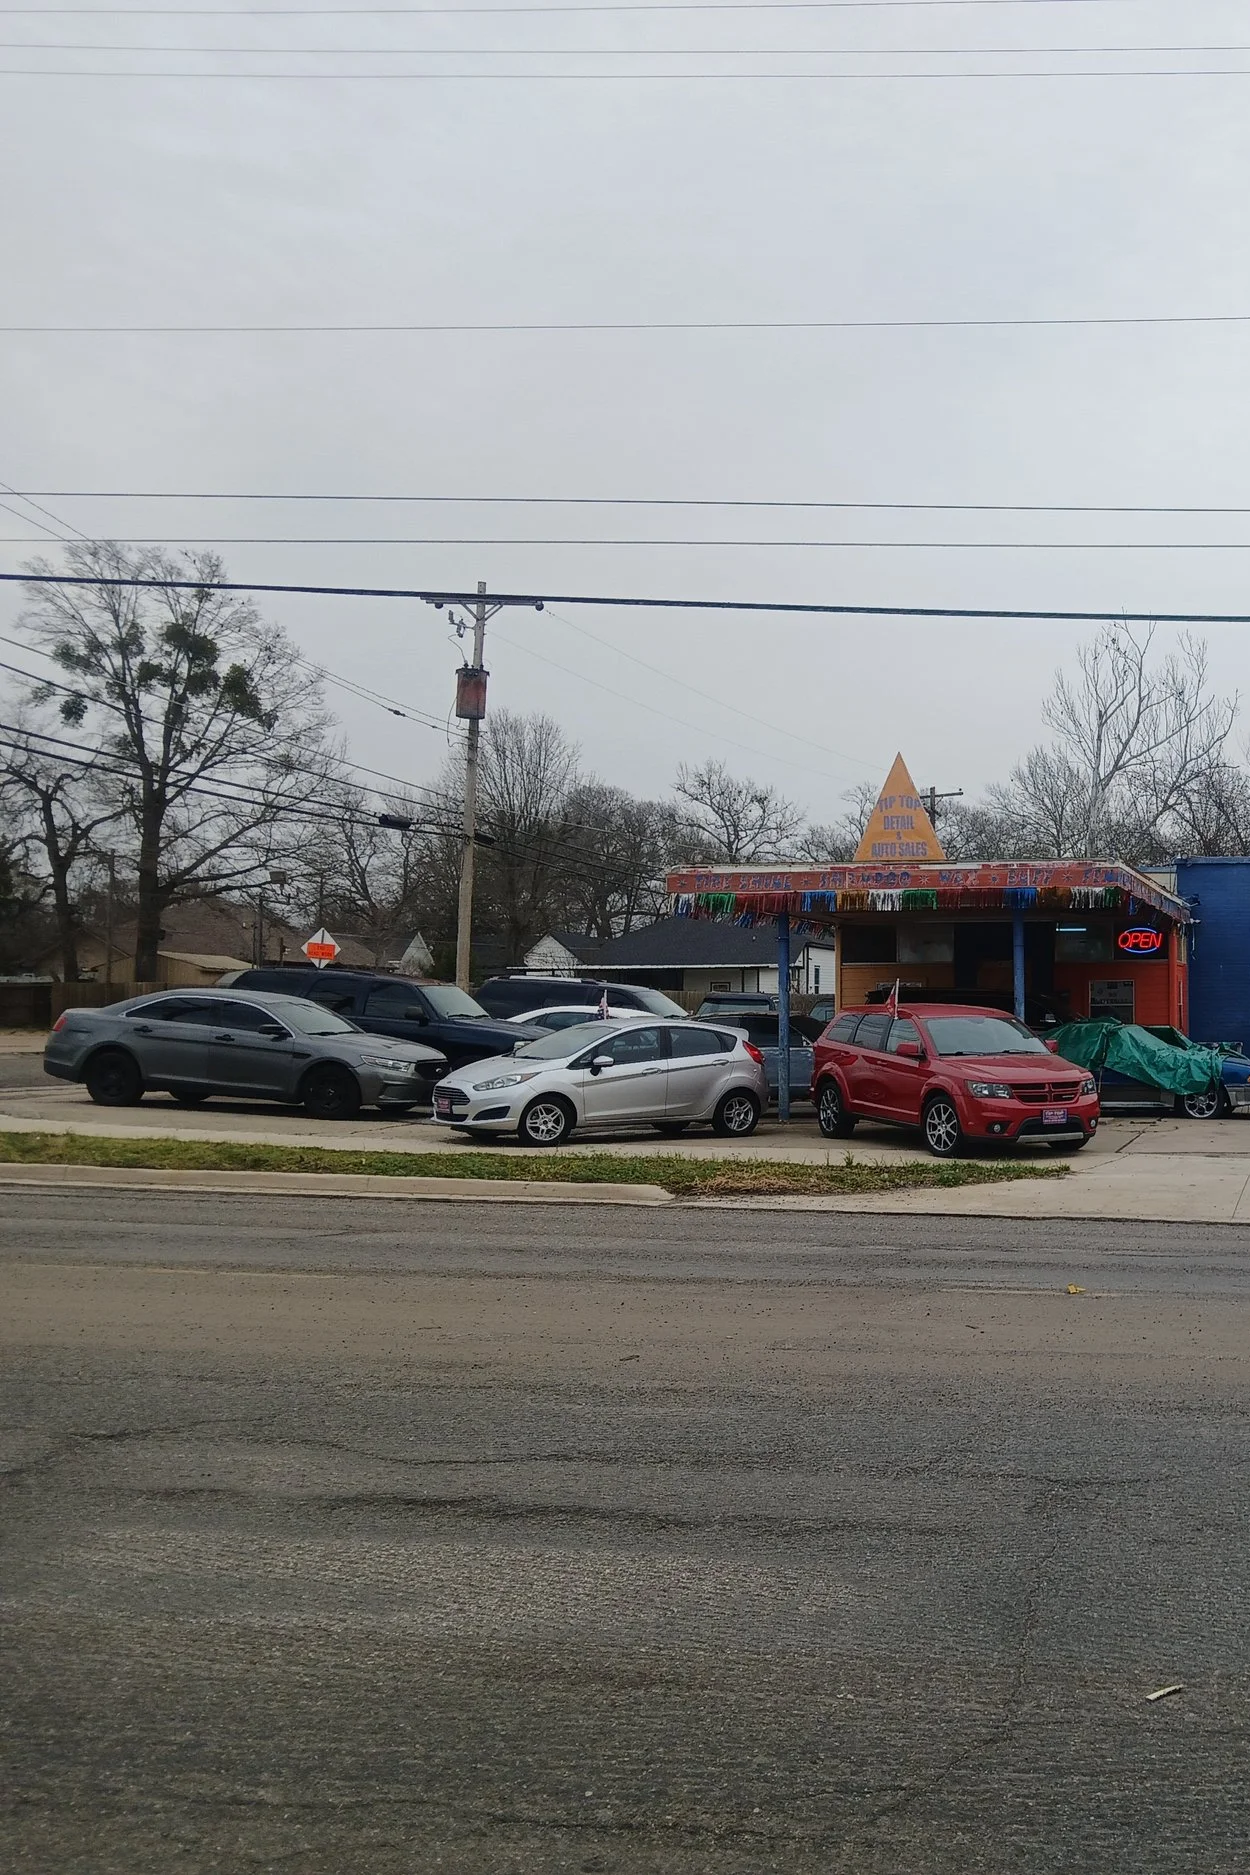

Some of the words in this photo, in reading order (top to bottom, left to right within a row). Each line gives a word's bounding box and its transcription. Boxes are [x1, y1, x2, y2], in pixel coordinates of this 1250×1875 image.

[879, 795, 896, 812] TIP
[899, 794, 921, 811] TOP
[883, 815, 914, 830] DETAIL
[896, 831, 902, 840] &
[871, 842, 897, 857] AUTO
[899, 841, 928, 856] SALES
[1007, 868, 1054, 886] BUFF
[1118, 932, 1162, 948] OPEN
